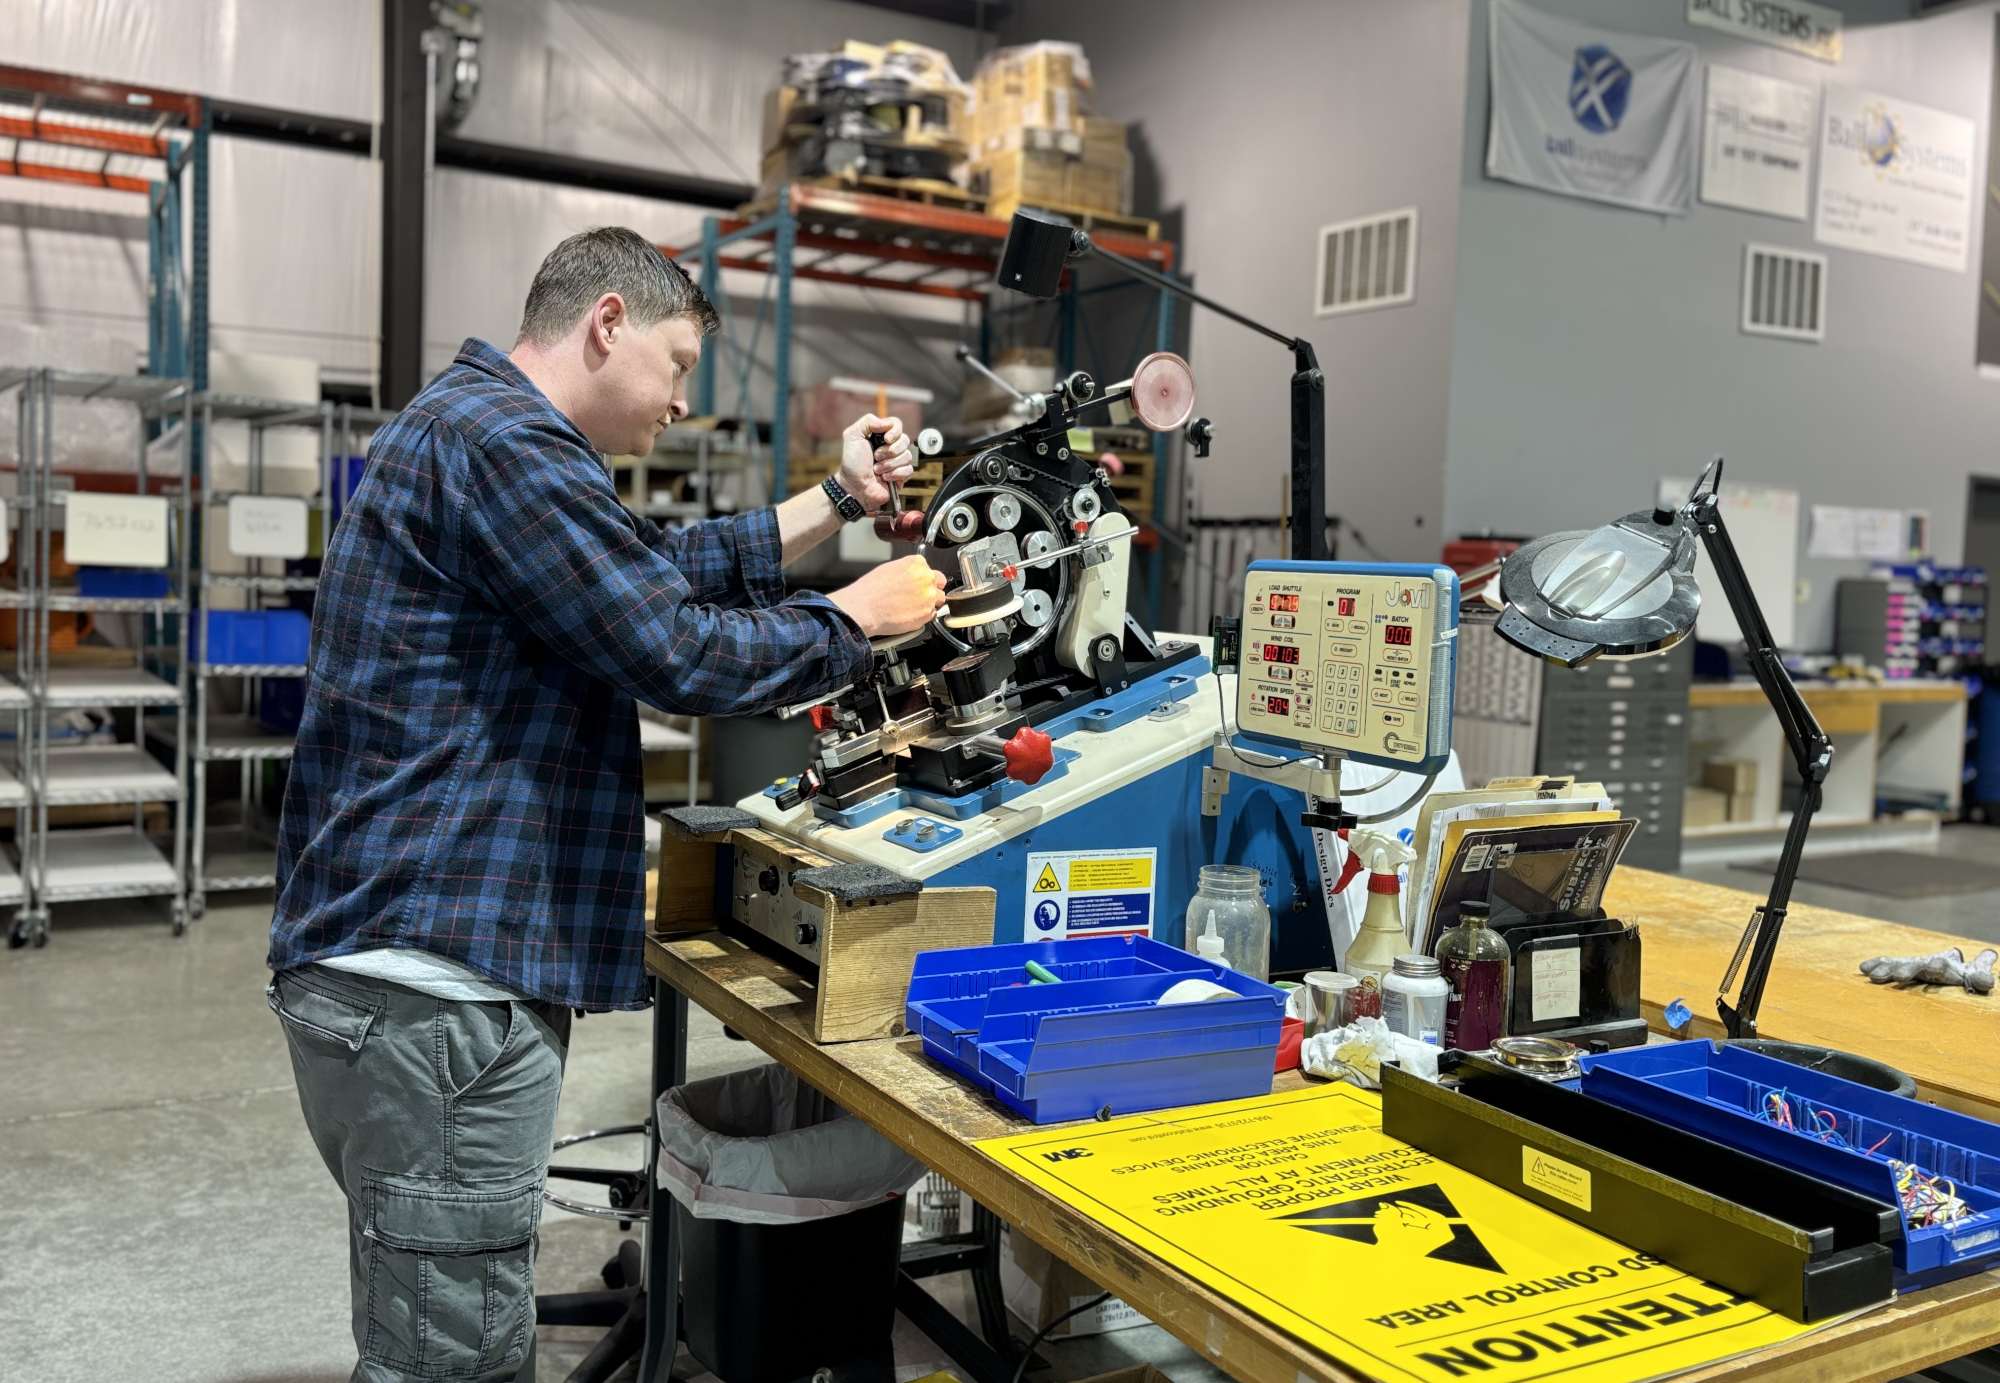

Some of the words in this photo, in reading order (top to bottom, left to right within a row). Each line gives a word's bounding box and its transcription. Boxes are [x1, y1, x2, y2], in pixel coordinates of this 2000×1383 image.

[1739, 1, 1810, 40] SYSTEMS
[1340, 599, 1355, 615] 01
[1386, 626, 1412, 644] 000
[1264, 646, 1299, 663] 00103
[1268, 698, 1289, 715] 204
[1393, 742, 1417, 752] UNIVERSAL
[1317, 832, 1329, 874] Design
[1324, 878, 1335, 908] Docs
[1560, 836, 1593, 911] SUBJECT
[1573, 871, 1589, 907] Wide
[1286, 1124, 1367, 1144] SENSITIVE
[1183, 1138, 1288, 1164] ELECTRONIC
[1255, 1144, 1300, 1158] AREA
[1306, 1138, 1342, 1150] THIS
[1040, 1147, 1094, 1163] 3M
[1170, 1153, 1256, 1174] CONTAINS
[1235, 1152, 1309, 1172] CAUTION
[1111, 1157, 1186, 1176] DEVICES
[1275, 1168, 1300, 1180] AT
[1293, 1155, 1434, 1190] ECTROSTATIC
[1544, 1163, 1556, 1171] Please
[1569, 1173, 1582, 1182] discard
[1226, 1174, 1270, 1187] ALL
[1350, 1174, 1411, 1193] WEAR
[1152, 1184, 1229, 1205] TIMES
[1153, 1182, 1295, 1217] GROUNDING
[1251, 1185, 1346, 1211] PROPER
[1617, 1253, 1668, 1272] SD
[1464, 1266, 1619, 1307] CONTROL
[1095, 1303, 1122, 1314] CARTON:
[1095, 1311, 1140, 1324] 15.28x12.87x1
[1364, 1300, 1466, 1330] AREA
